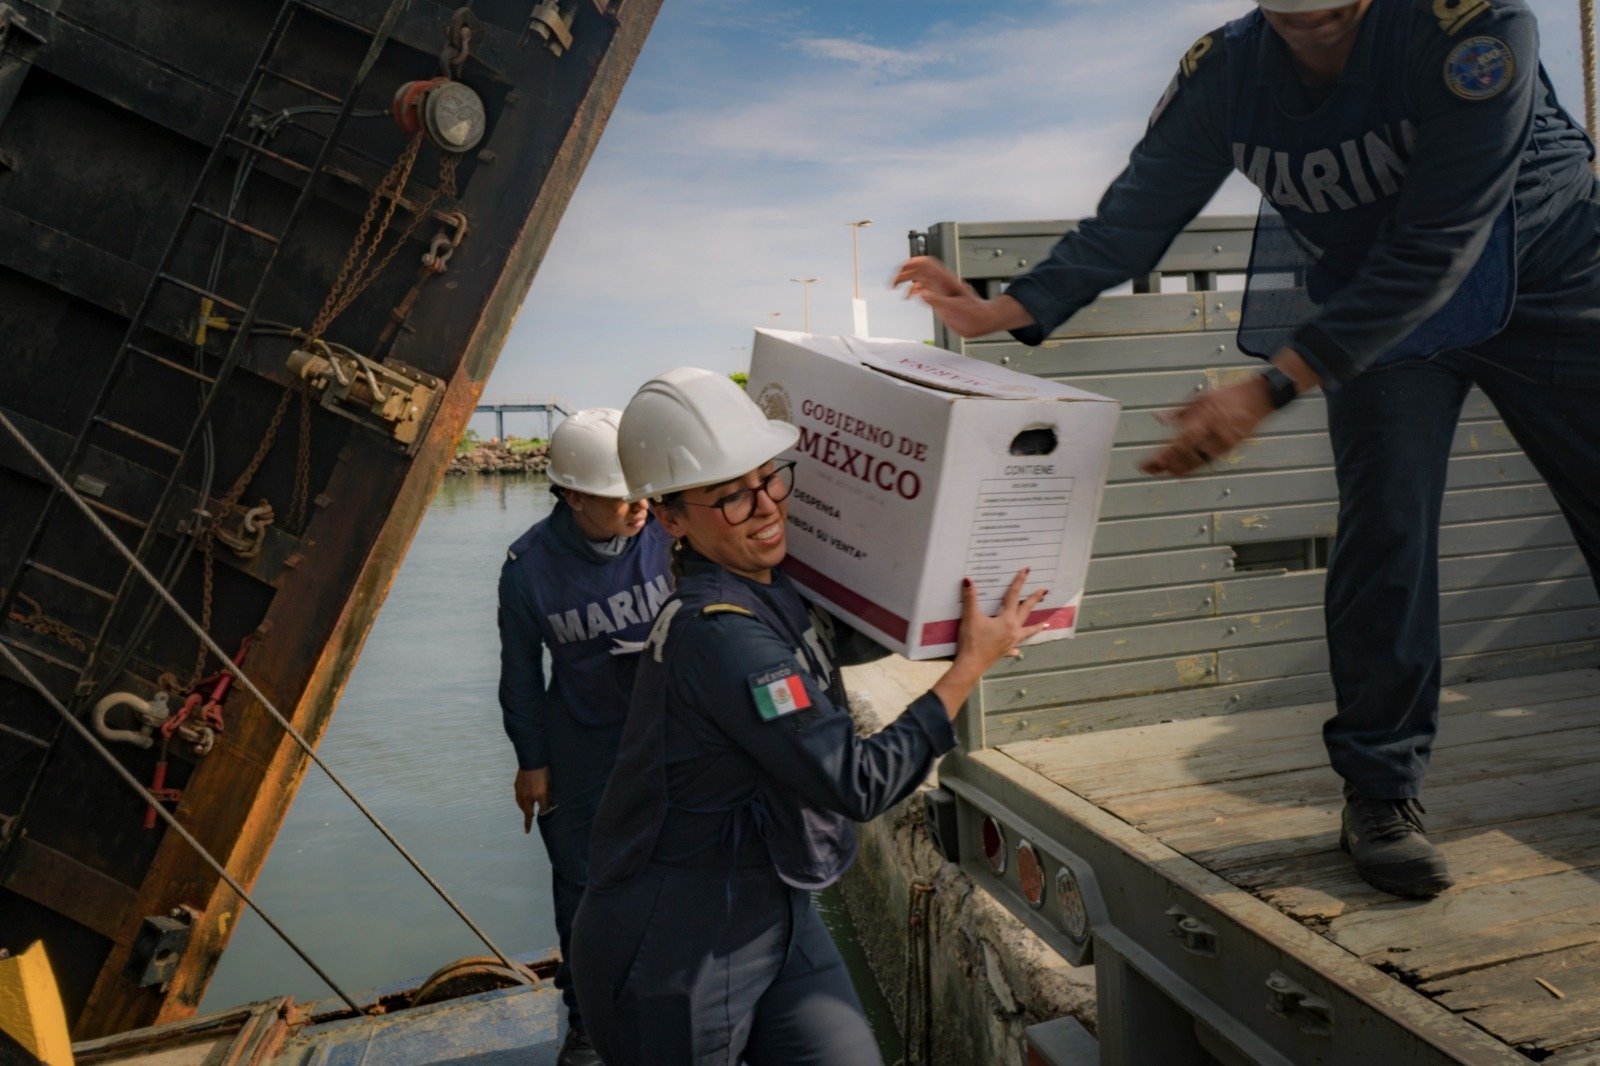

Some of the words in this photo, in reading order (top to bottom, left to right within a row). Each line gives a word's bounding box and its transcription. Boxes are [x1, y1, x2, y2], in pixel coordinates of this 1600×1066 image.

[801, 399, 895, 449] GOBIERNO
[897, 436, 928, 462] DE
[795, 425, 922, 500] MÉXICO
[793, 488, 841, 519] DESPENSA
[816, 529, 829, 542] SU
